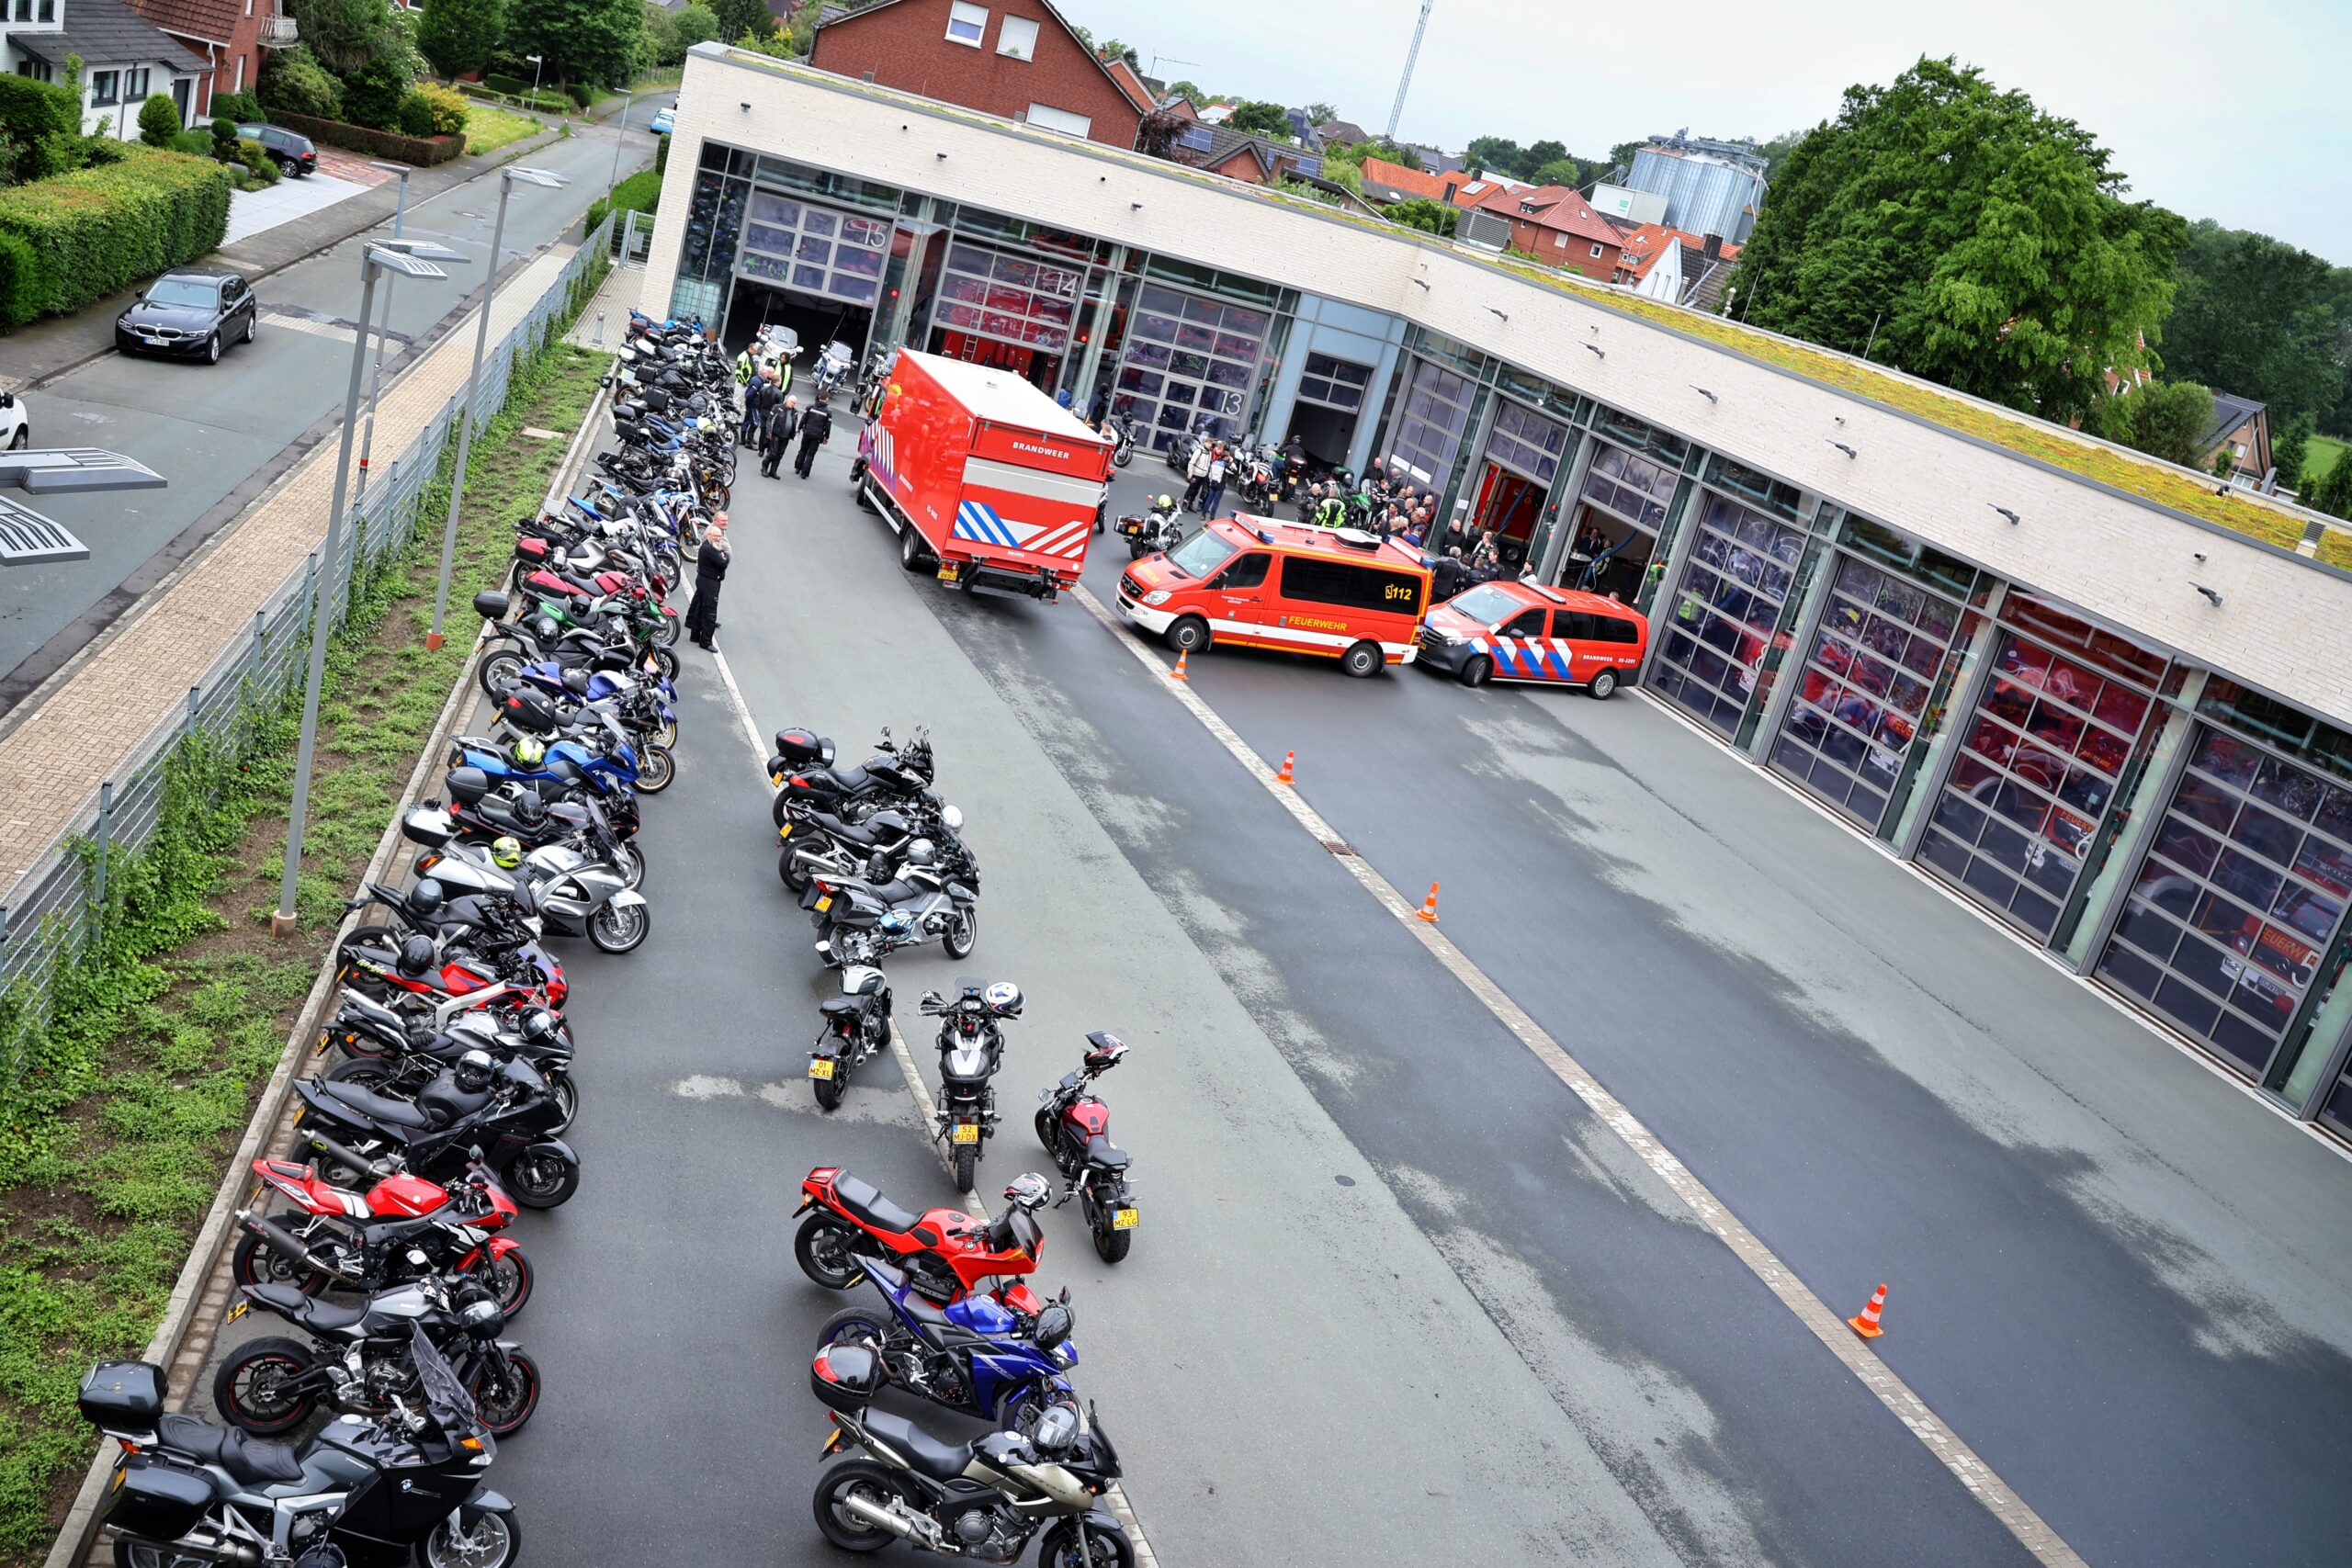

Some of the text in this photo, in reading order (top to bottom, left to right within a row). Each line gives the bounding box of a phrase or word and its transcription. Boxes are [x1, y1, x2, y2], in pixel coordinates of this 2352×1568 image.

[865, 221, 888, 247] 15
[1056, 272, 1077, 298] 14
[1221, 391, 1242, 415] 13
[1012, 442, 1069, 459] BRANDWEER
[1393, 587, 1412, 601] 112
[1289, 615, 1348, 631] FEUERWEHR
[1583, 654, 1613, 662] BRANDWEER
